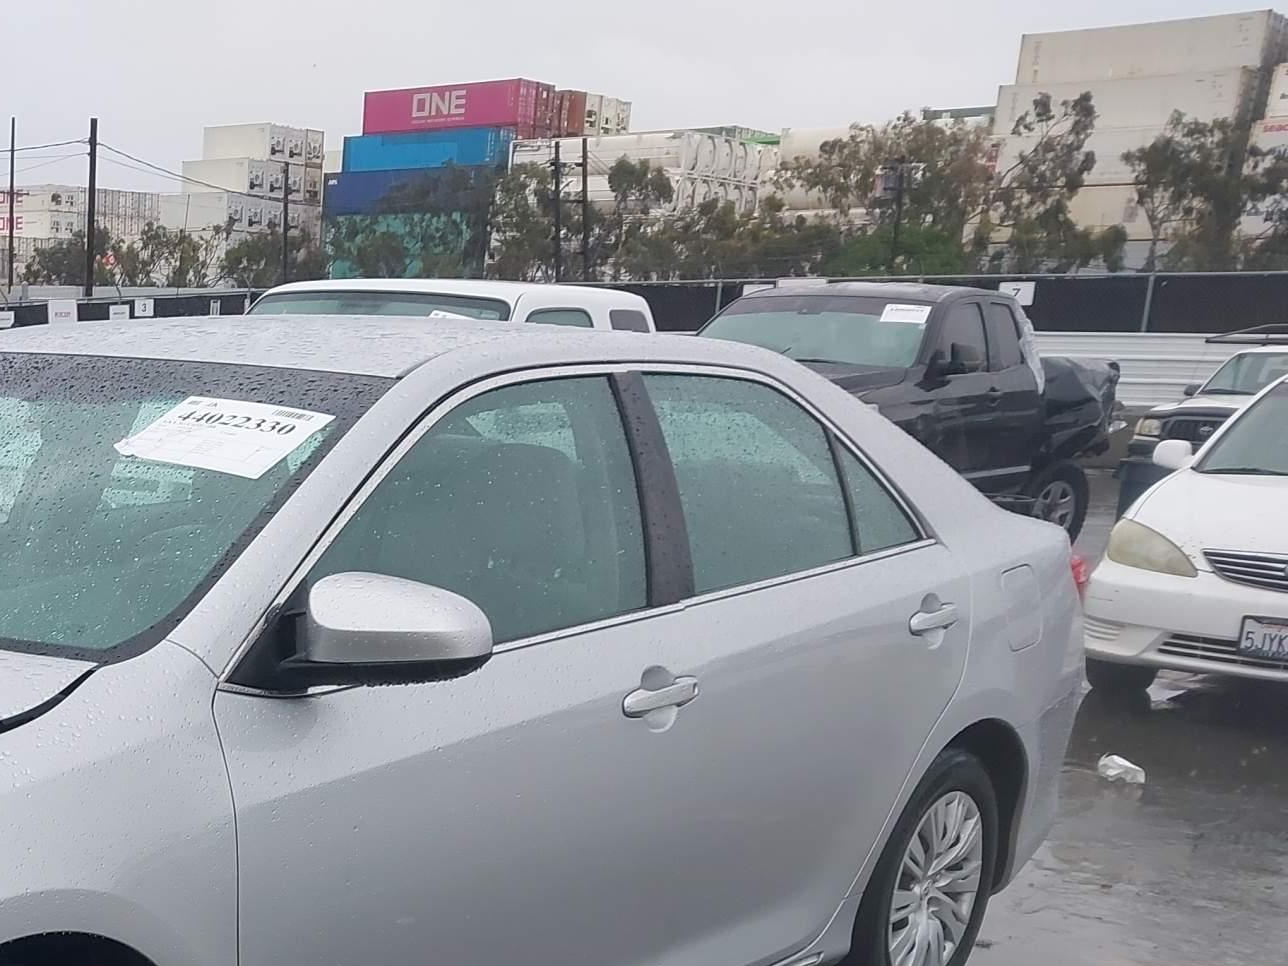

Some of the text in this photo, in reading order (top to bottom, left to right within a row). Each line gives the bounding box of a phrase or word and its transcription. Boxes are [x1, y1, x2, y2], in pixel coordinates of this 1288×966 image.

[412, 89, 466, 117] ONE
[1012, 287, 1021, 297] 7
[140, 303, 147, 313] 3
[177, 410, 297, 436] 44022330
